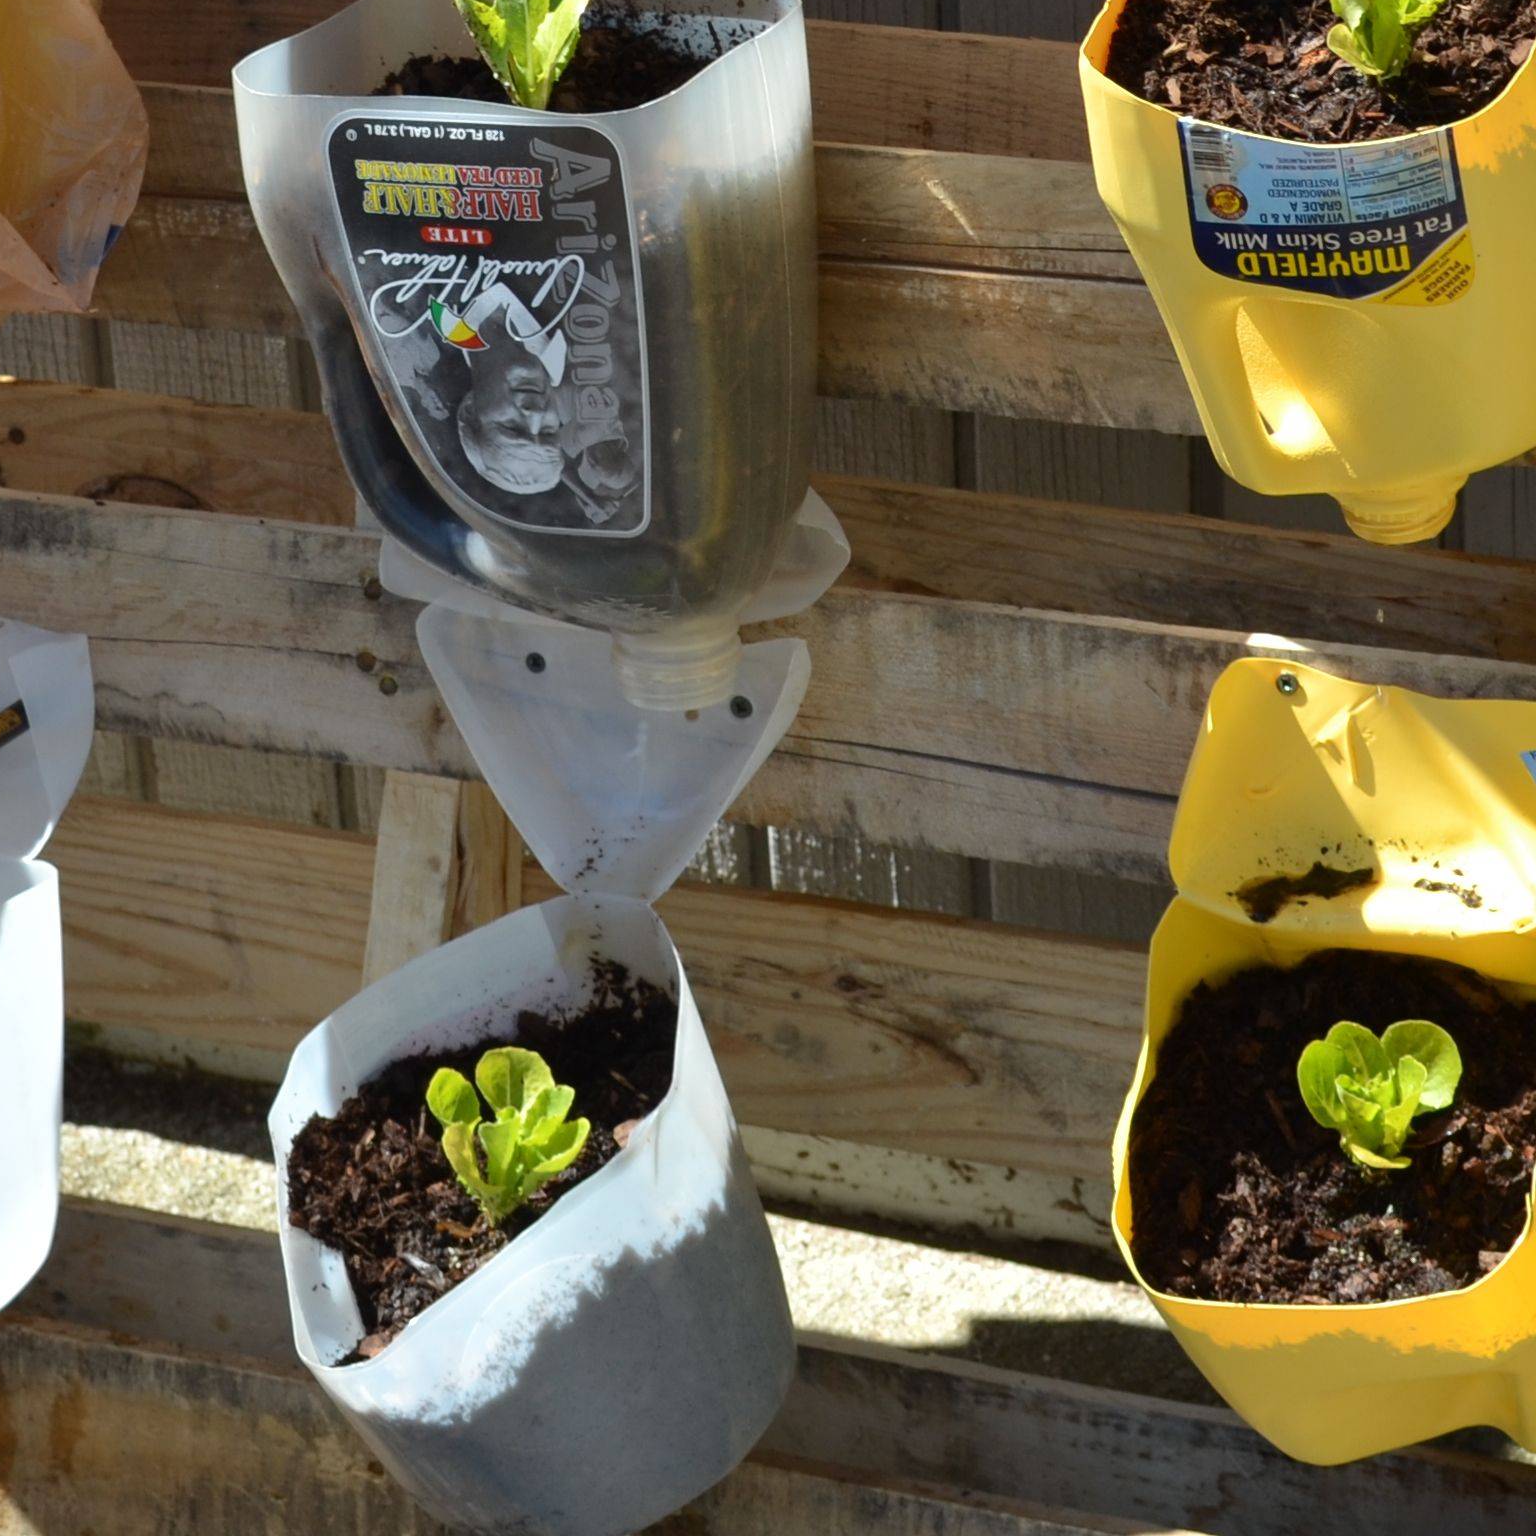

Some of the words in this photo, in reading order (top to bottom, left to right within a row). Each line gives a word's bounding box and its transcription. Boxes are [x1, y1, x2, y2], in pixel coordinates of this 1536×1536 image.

[364, 124, 373, 135] L
[376, 124, 397, 136] 3.78
[485, 128, 505, 141] 128
[354, 159, 455, 181] LEMONADE
[458, 165, 494, 185] TEA
[498, 167, 542, 187] ICED
[1272, 178, 1339, 188] PASTEURIZED
[1267, 188, 1340, 198] HOMOGENIZED
[1289, 202, 1302, 211] A
[1308, 200, 1342, 212] GRADE
[1393, 195, 1445, 216] Nutrition
[1259, 213, 1269, 223] D
[1270, 213, 1280, 222] &
[1282, 213, 1293, 223] A
[1294, 212, 1345, 223] VITAMIN
[1355, 210, 1389, 222] Facts
[1414, 213, 1452, 233] Fat
[426, 227, 485, 243] LITE
[1214, 231, 1268, 249] Milk
[1276, 232, 1340, 250] Skim
[1348, 225, 1406, 249] Free
[1236, 244, 1410, 277] MAYFIELD
[1422, 260, 1461, 293] PLEDGE
[1425, 262, 1471, 303] FARMERS
[363, 248, 471, 339] Palmer
[466, 251, 585, 342] Arnold
[1445, 279, 1469, 300] OUR
